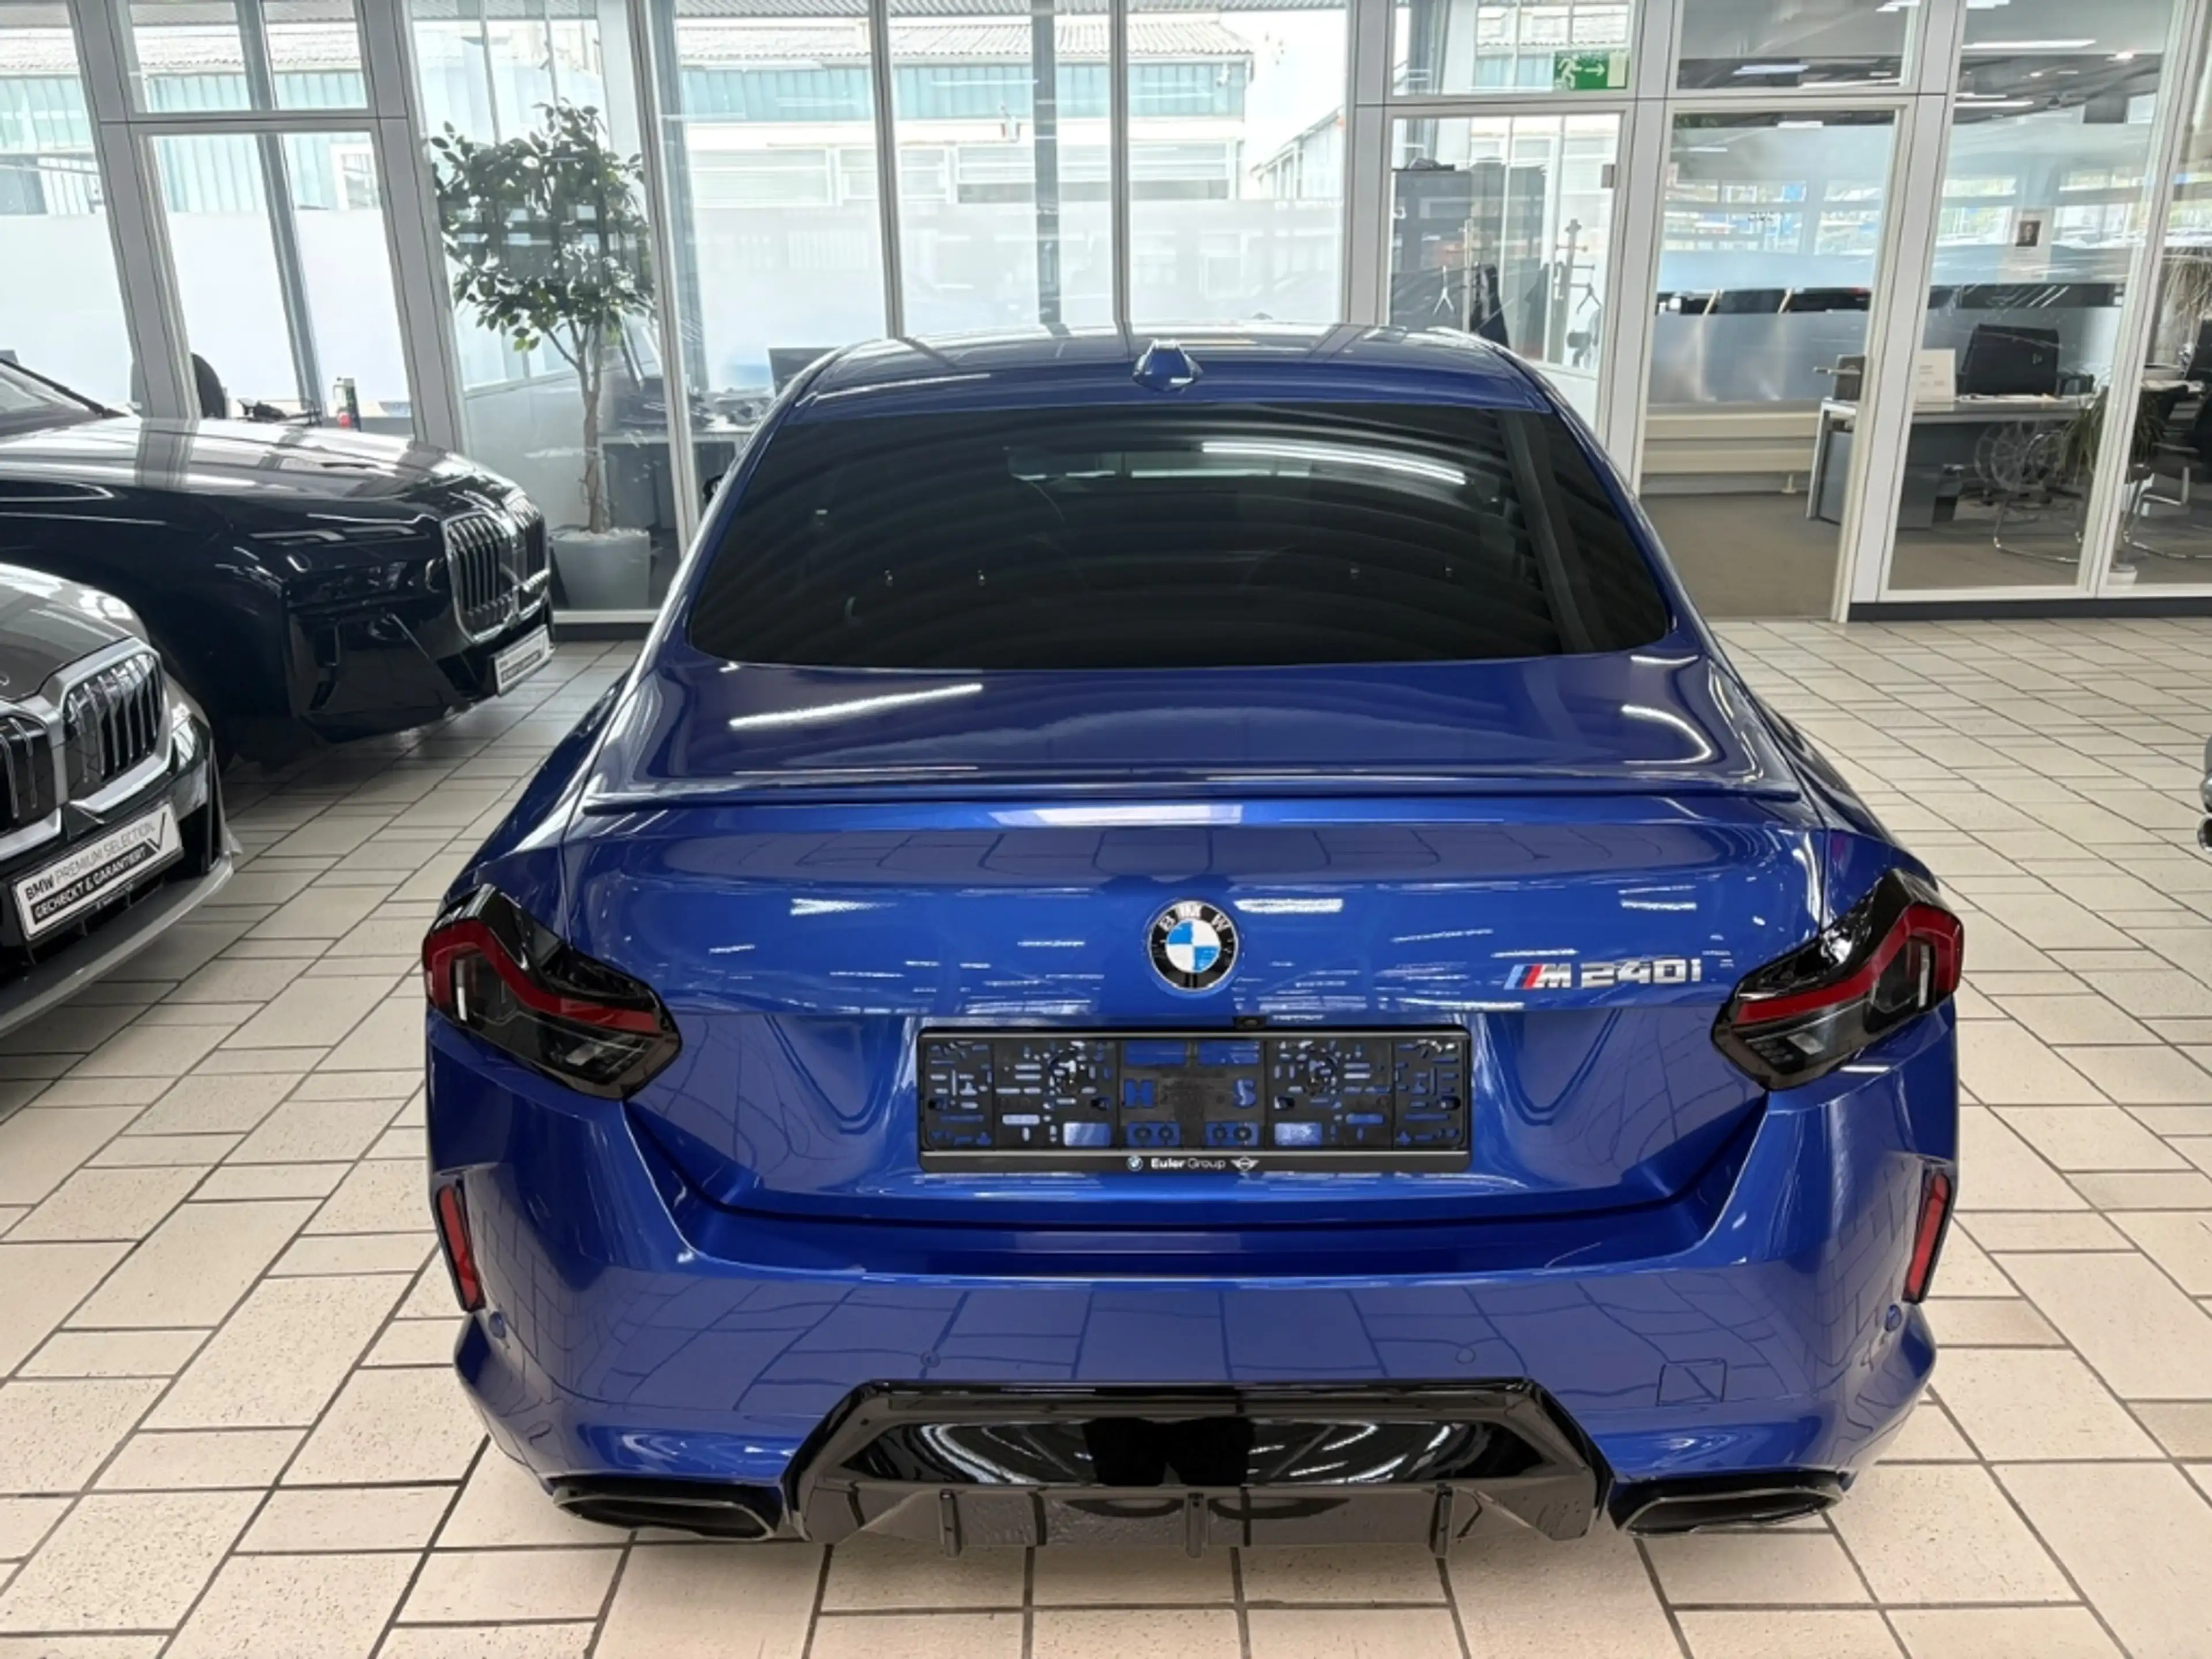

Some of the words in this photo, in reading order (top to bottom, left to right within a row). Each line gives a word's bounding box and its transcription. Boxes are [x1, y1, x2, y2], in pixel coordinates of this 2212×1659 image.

[25, 874, 55, 902] BMW
[55, 847, 103, 884] PREMIUM
[103, 821, 156, 857] SELECTION
[1158, 902, 1232, 932] BMW
